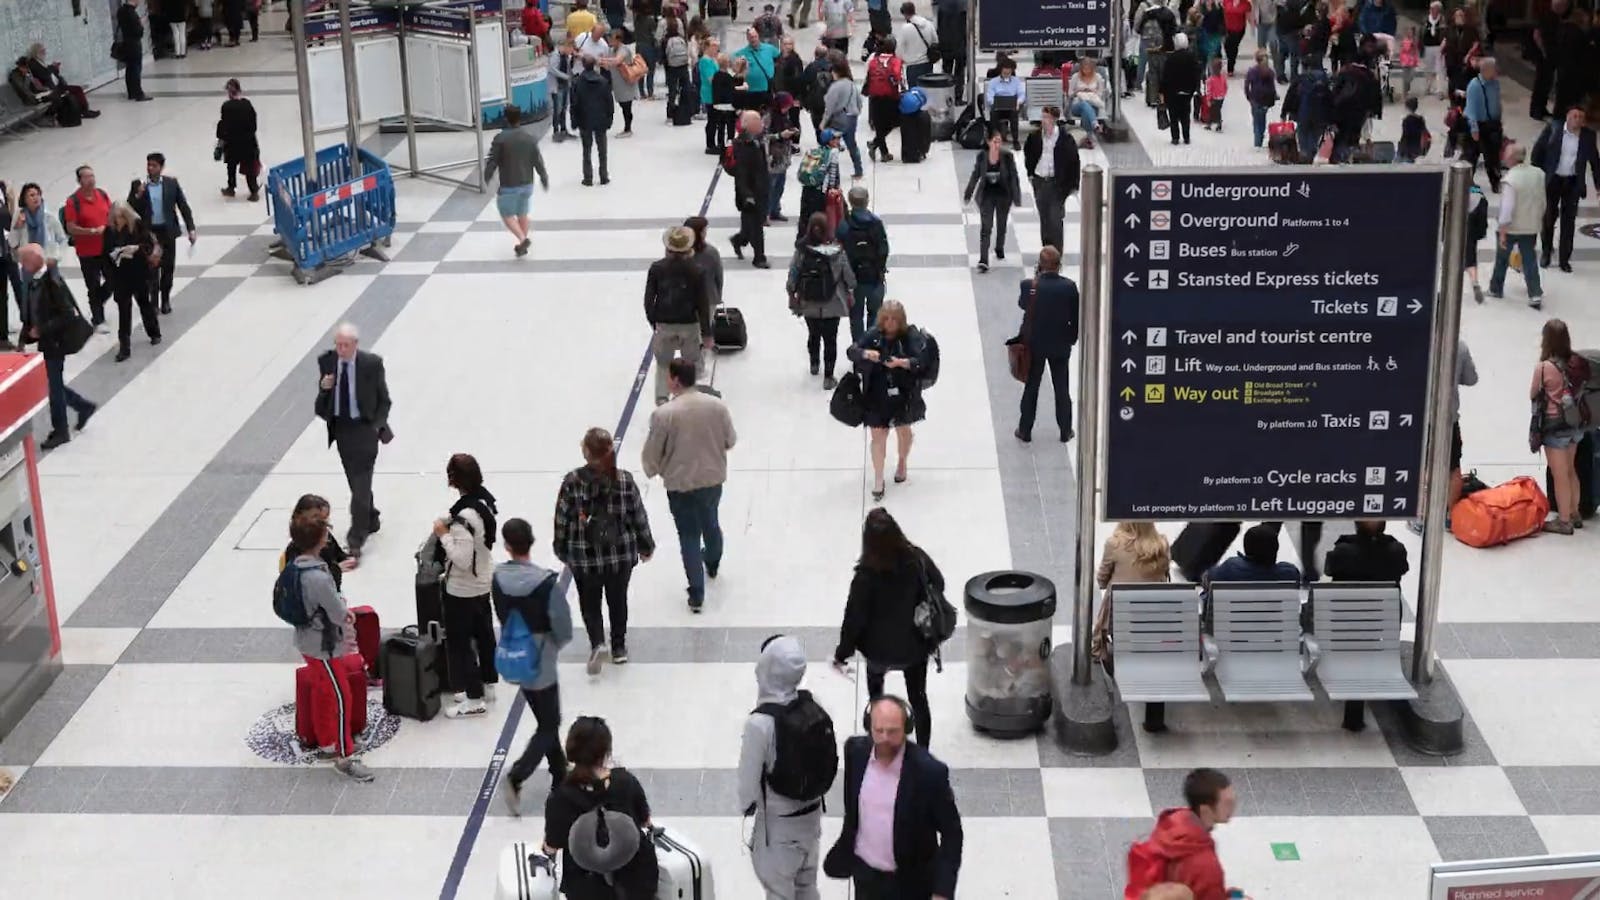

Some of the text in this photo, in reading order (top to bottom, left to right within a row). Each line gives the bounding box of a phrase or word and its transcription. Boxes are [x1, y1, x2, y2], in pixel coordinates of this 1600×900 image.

[1046, 27, 1065, 35] Cycle
[1055, 39, 1084, 47] Luggage
[1181, 183, 1290, 200] Underground
[1180, 212, 1278, 230] Overground
[1282, 218, 1323, 227] Platforms
[1325, 218, 1331, 226] 1
[1343, 218, 1349, 226] 4
[1179, 243, 1227, 258] Buses
[1178, 271, 1379, 290] Stansted Express tickets
[1311, 300, 1368, 314] Tickets
[1176, 330, 1372, 344] Travel and tourist centre
[1175, 358, 1202, 372] Lift
[1206, 363, 1223, 373] Way
[1243, 363, 1297, 373] Underground
[1299, 363, 1313, 371] and
[1316, 363, 1330, 371] Bus
[1332, 363, 1361, 371] station
[1174, 387, 1239, 403] Way out
[1258, 414, 1360, 429] By platform 10 Taxis
[1203, 470, 1357, 487] By platform 10 Cycle racks
[1132, 498, 1355, 514] Lost property by platform 10 Left Luggage
[1454, 888, 1544, 900] Planned service
